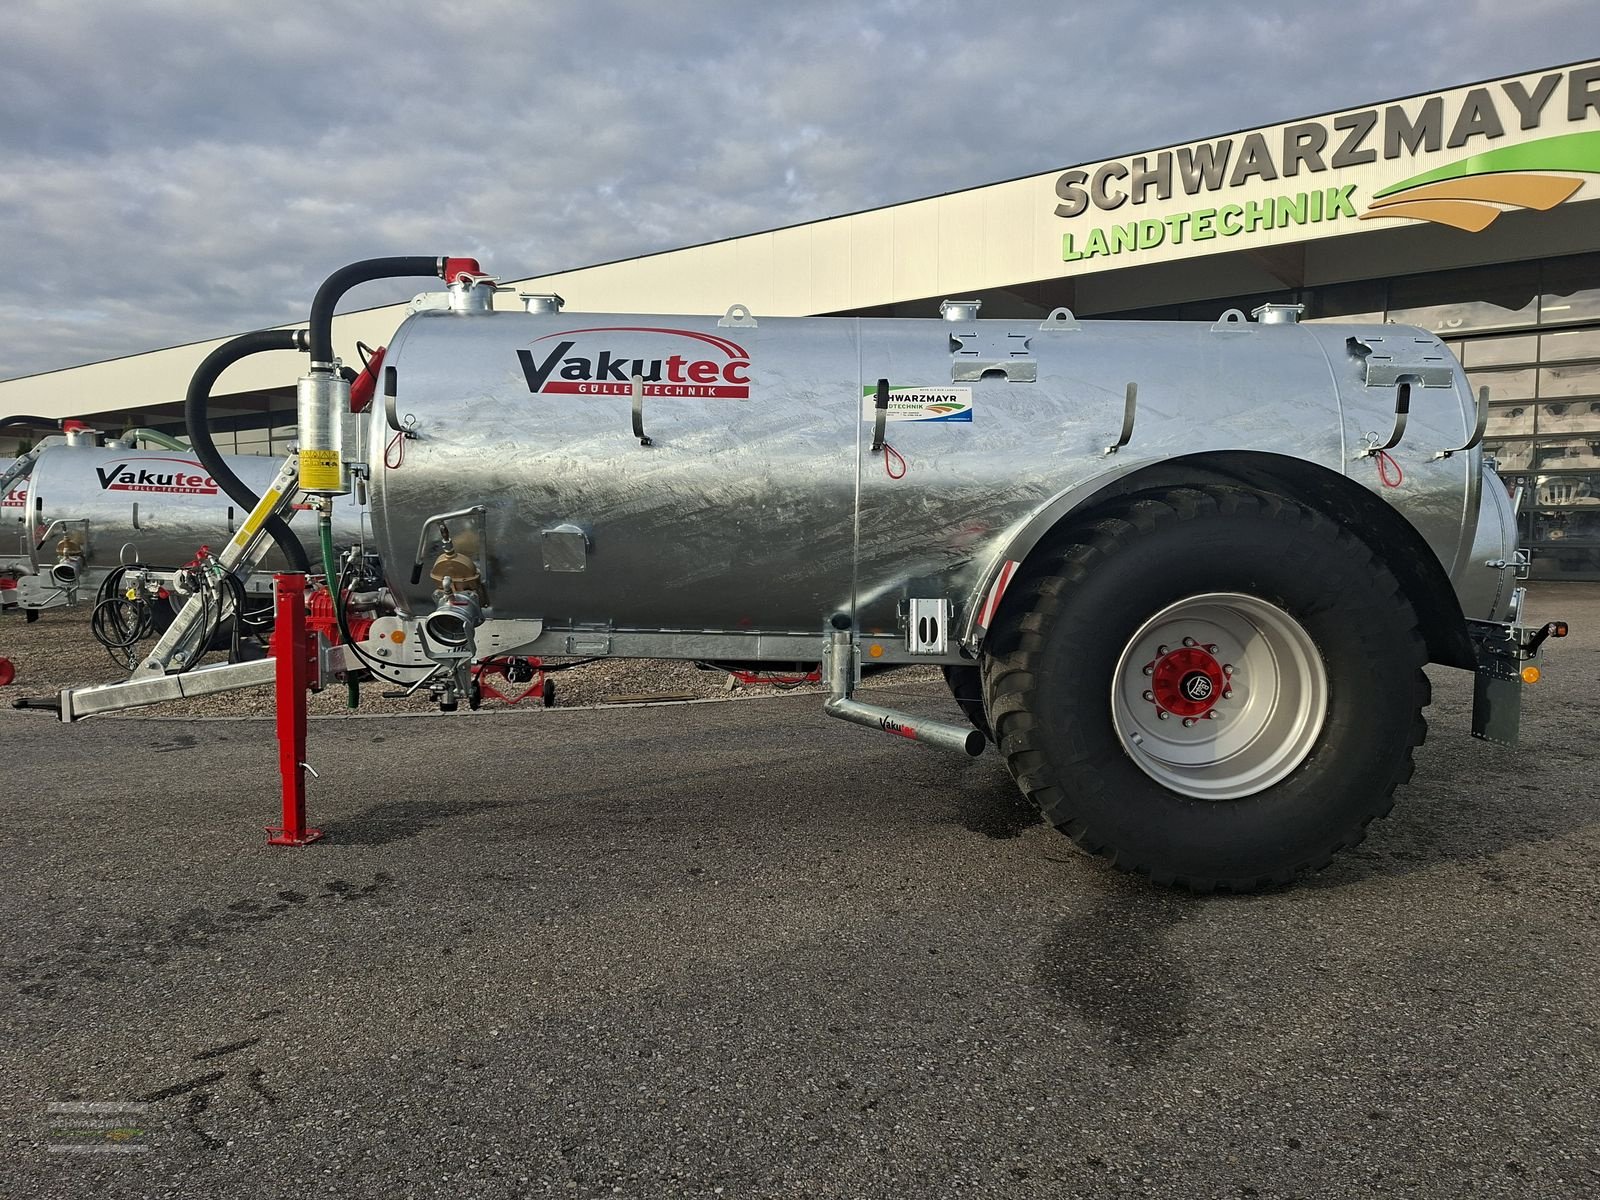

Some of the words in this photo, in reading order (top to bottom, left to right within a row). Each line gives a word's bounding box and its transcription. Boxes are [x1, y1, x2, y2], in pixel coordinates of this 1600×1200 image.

[1055, 66, 1600, 218] SCHWARZMAYR
[1062, 184, 1358, 262] LANDTECHNIK
[516, 341, 751, 394] Vakutec
[873, 394, 957, 403] SHWARZMAYR
[96, 464, 218, 489] Vakutec
